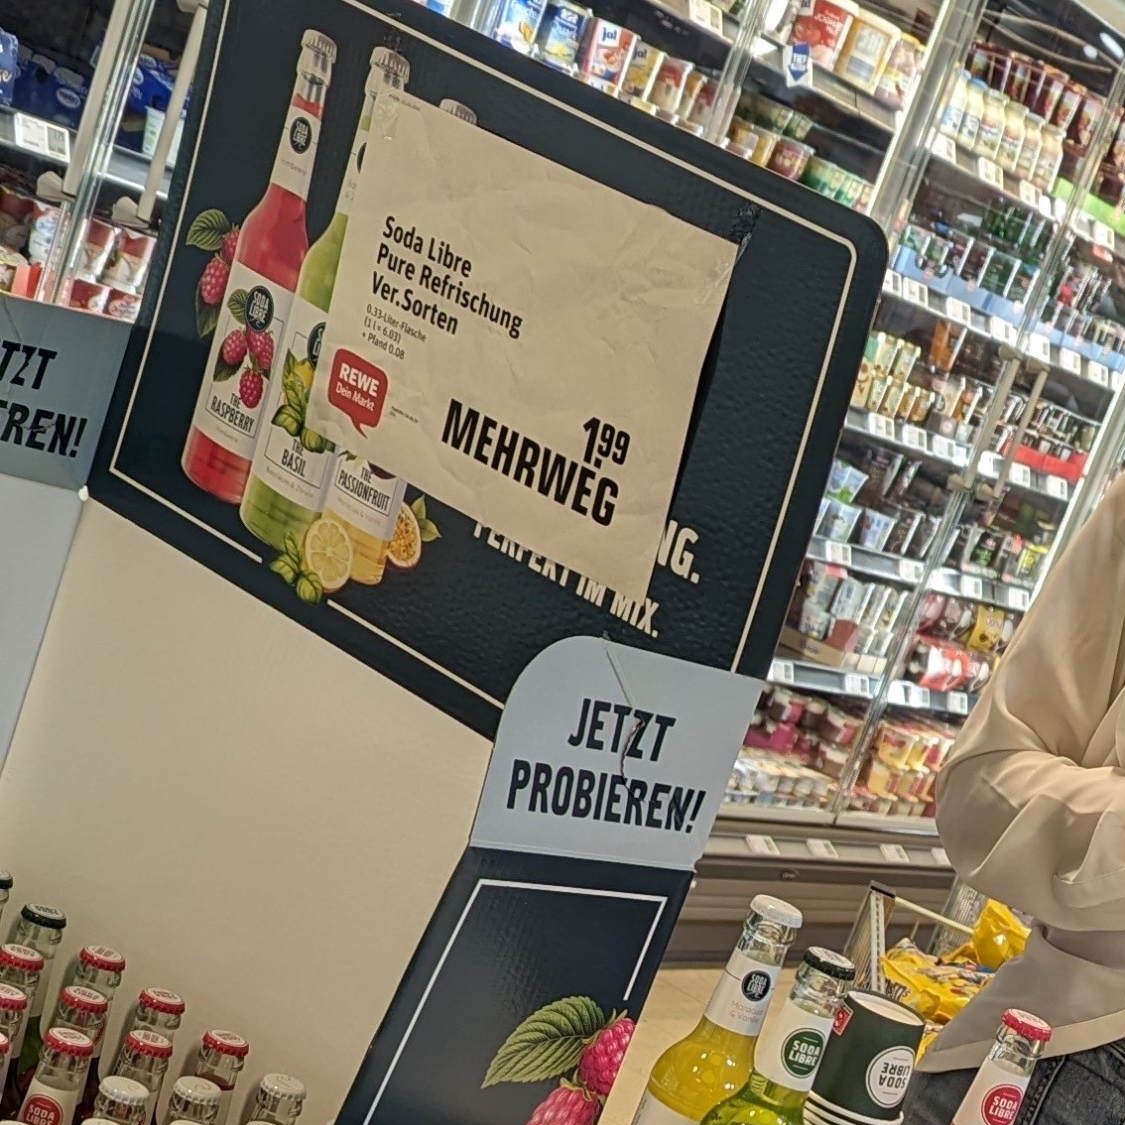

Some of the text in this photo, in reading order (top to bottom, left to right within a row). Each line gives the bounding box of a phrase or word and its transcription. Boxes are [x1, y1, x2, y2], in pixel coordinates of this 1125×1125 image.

[382, 215, 472, 278] Soda Libre
[253, 290, 270, 307] SODA
[372, 271, 459, 335] Ver.Sorten
[376, 242, 523, 339] Pure Refrischung
[249, 304, 267, 324] LIBRE
[366, 303, 427, 343] 0.33-Liter-Flasche
[367, 332, 388, 351] Pfand
[388, 345, 405, 360] 0.08
[0, 340, 58, 390] TZT
[339, 362, 380, 397] REWE
[335, 381, 352, 399] Dein
[210, 395, 255, 433] RASPBERRY
[281, 448, 307, 478] BASIL
[441, 398, 619, 526] MEHRWEG
[337, 469, 391, 512] PASSIONFRUIT
[567, 698, 677, 762] JETZT
[506, 758, 707, 834] PROBIEREN!
[751, 973, 768, 986] SODA
[788, 1050, 818, 1067] LIBRE
[792, 1040, 821, 1057] SODA
[28, 1104, 55, 1121] SODA
[988, 1106, 1015, 1120] LIBRE
[991, 1096, 1019, 1111] SODA
